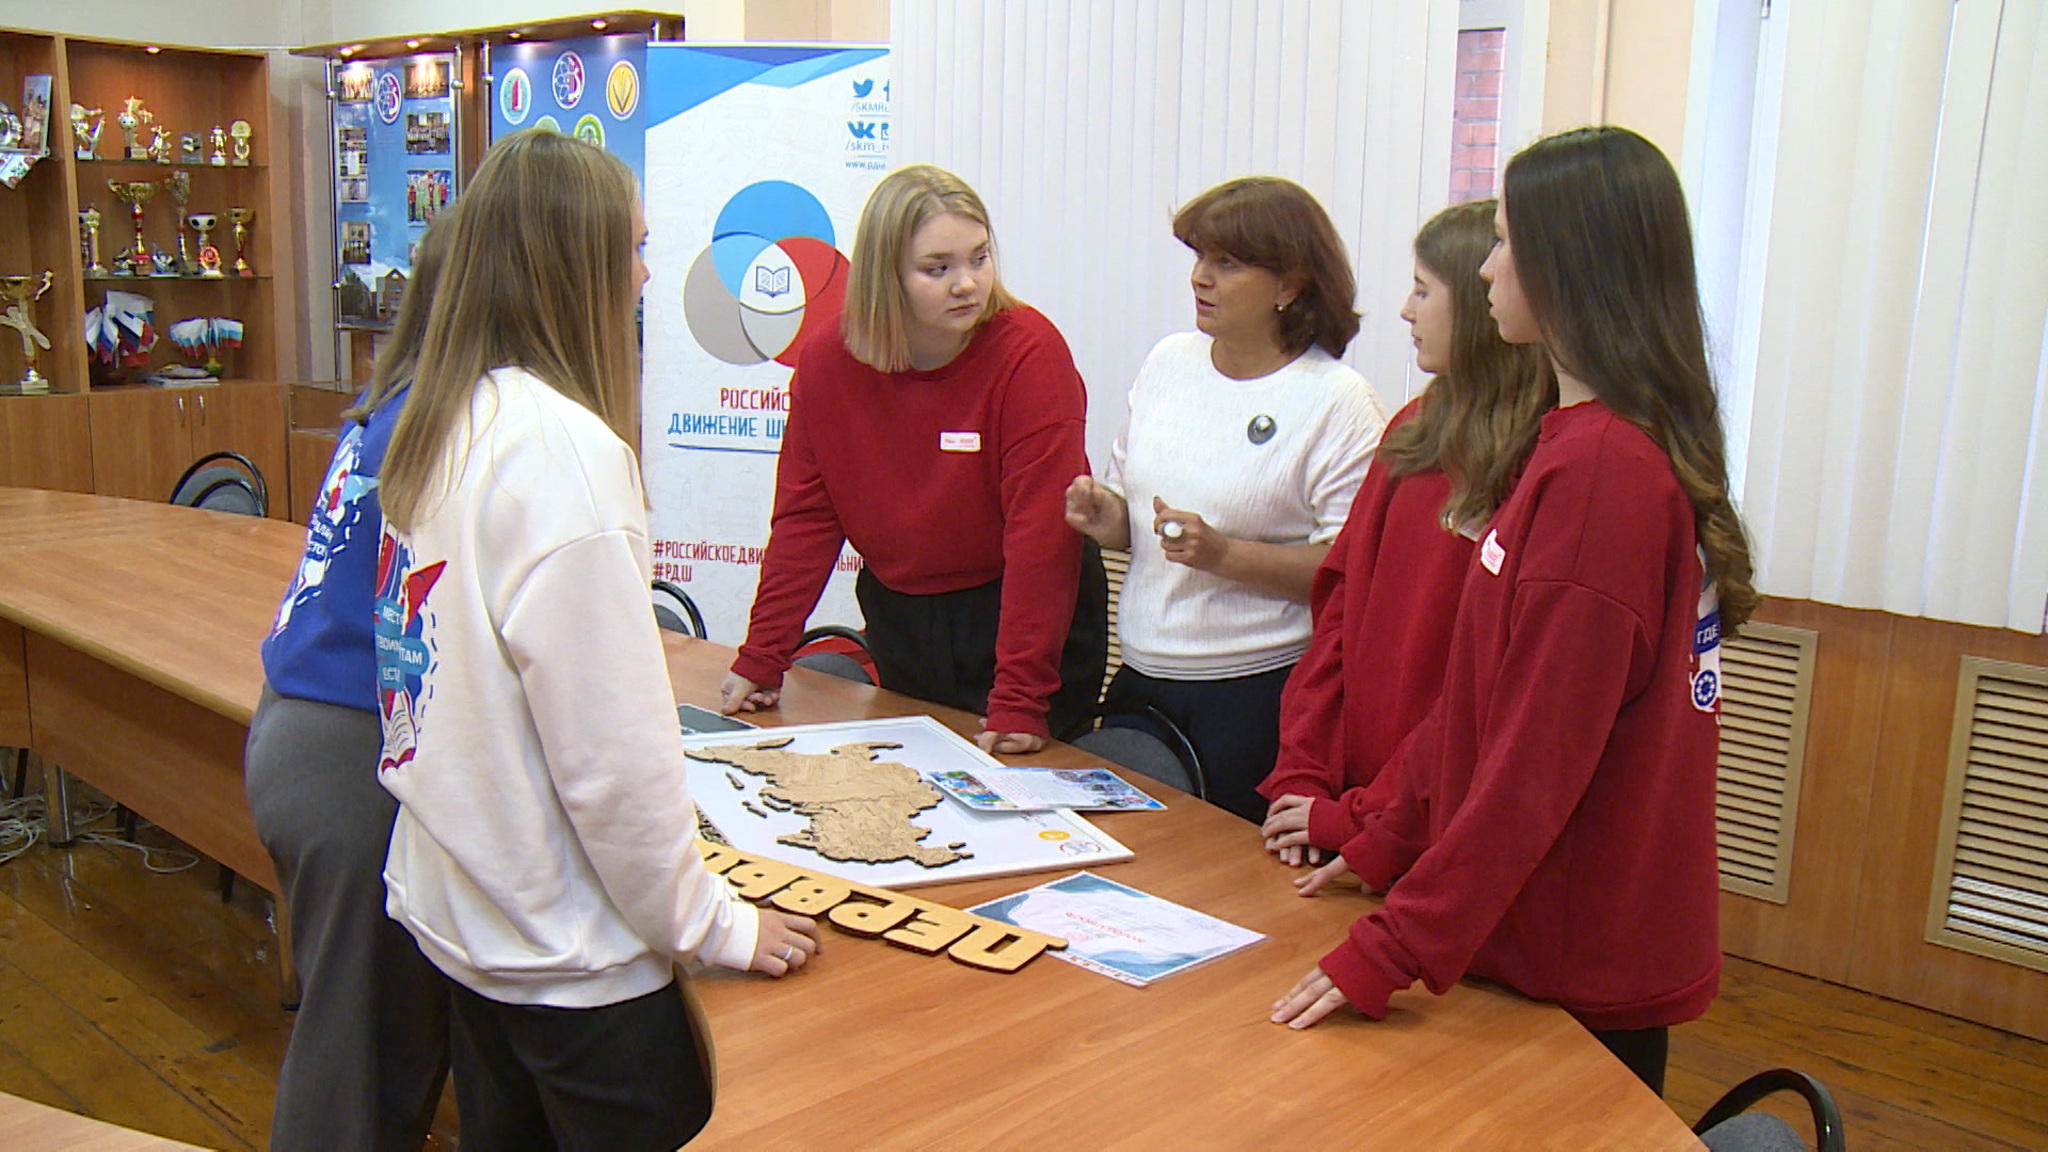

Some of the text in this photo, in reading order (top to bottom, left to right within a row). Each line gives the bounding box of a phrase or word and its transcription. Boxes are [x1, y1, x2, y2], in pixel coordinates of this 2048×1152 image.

[845, 140, 889, 153] /skm_r
[720, 387, 791, 412] РОССИЙС
[667, 412, 758, 437] ДВИЖЕНИЕ
[653, 539, 764, 565] #РОССИЙСКОЕДВИ
[653, 562, 692, 583] #РДШ
[1697, 624, 1719, 644] ГДЕ
[694, 838, 1068, 974] ПЕРВЫ
